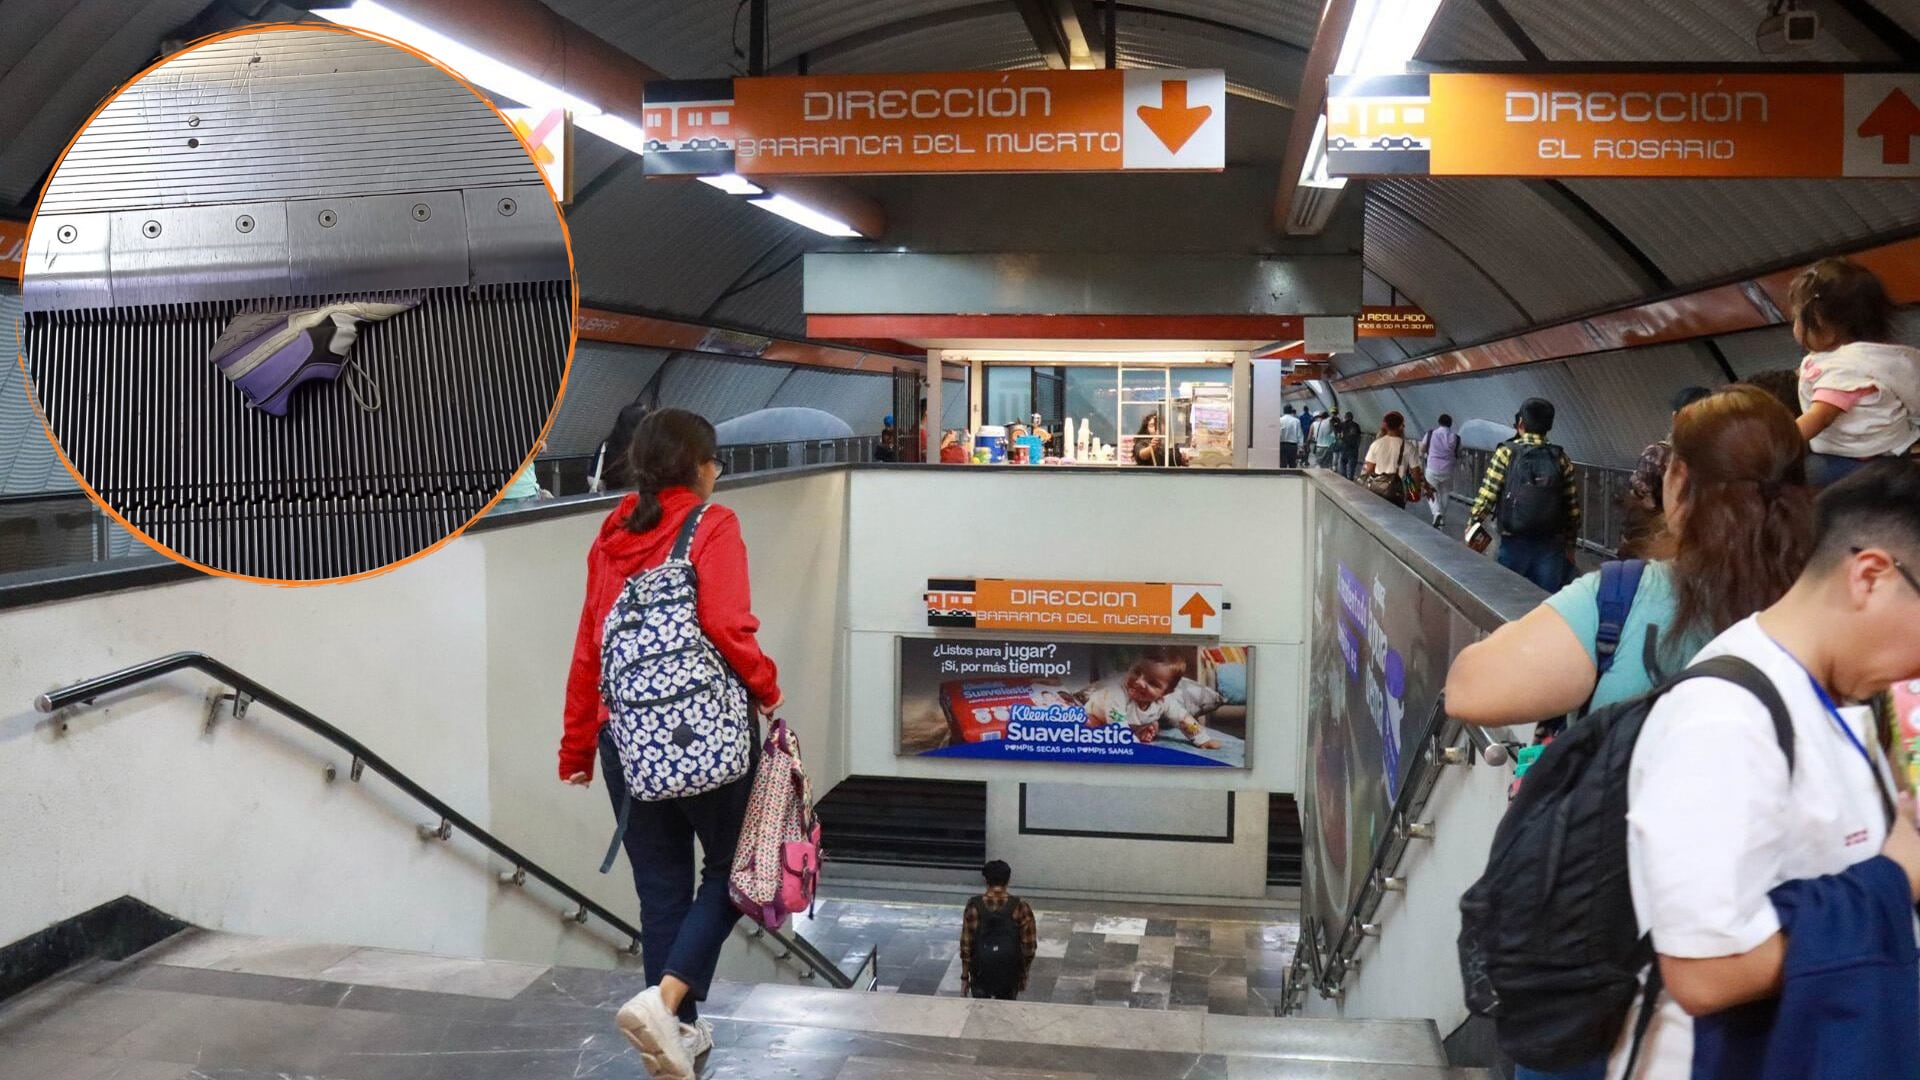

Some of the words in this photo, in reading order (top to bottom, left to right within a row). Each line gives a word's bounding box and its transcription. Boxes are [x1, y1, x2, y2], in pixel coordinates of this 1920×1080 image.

[804, 75, 1051, 121] DIRECCIÓN
[1505, 78, 1769, 123] DIRECCIÓN
[738, 134, 903, 158] BARRANCA
[913, 133, 976, 155] DEL
[986, 131, 1122, 154] MUERTO
[1538, 138, 1582, 159] EL
[1593, 138, 1735, 160] ROSARIO
[1367, 312, 1426, 322] REGULADO
[1010, 588, 1137, 608] DIRECCION
[976, 609, 1063, 623] BARRANCA
[1066, 612, 1099, 625] DEL
[1103, 612, 1172, 626] MUERTO
[933, 643, 974, 658] ¿Listos
[975, 646, 1002, 659] para
[1002, 642, 1057, 661] jugar?
[960, 661, 981, 674] por
[982, 660, 1007, 673] más
[1008, 659, 1071, 678] tiempo!
[1007, 722, 1132, 745] Suavelastic
